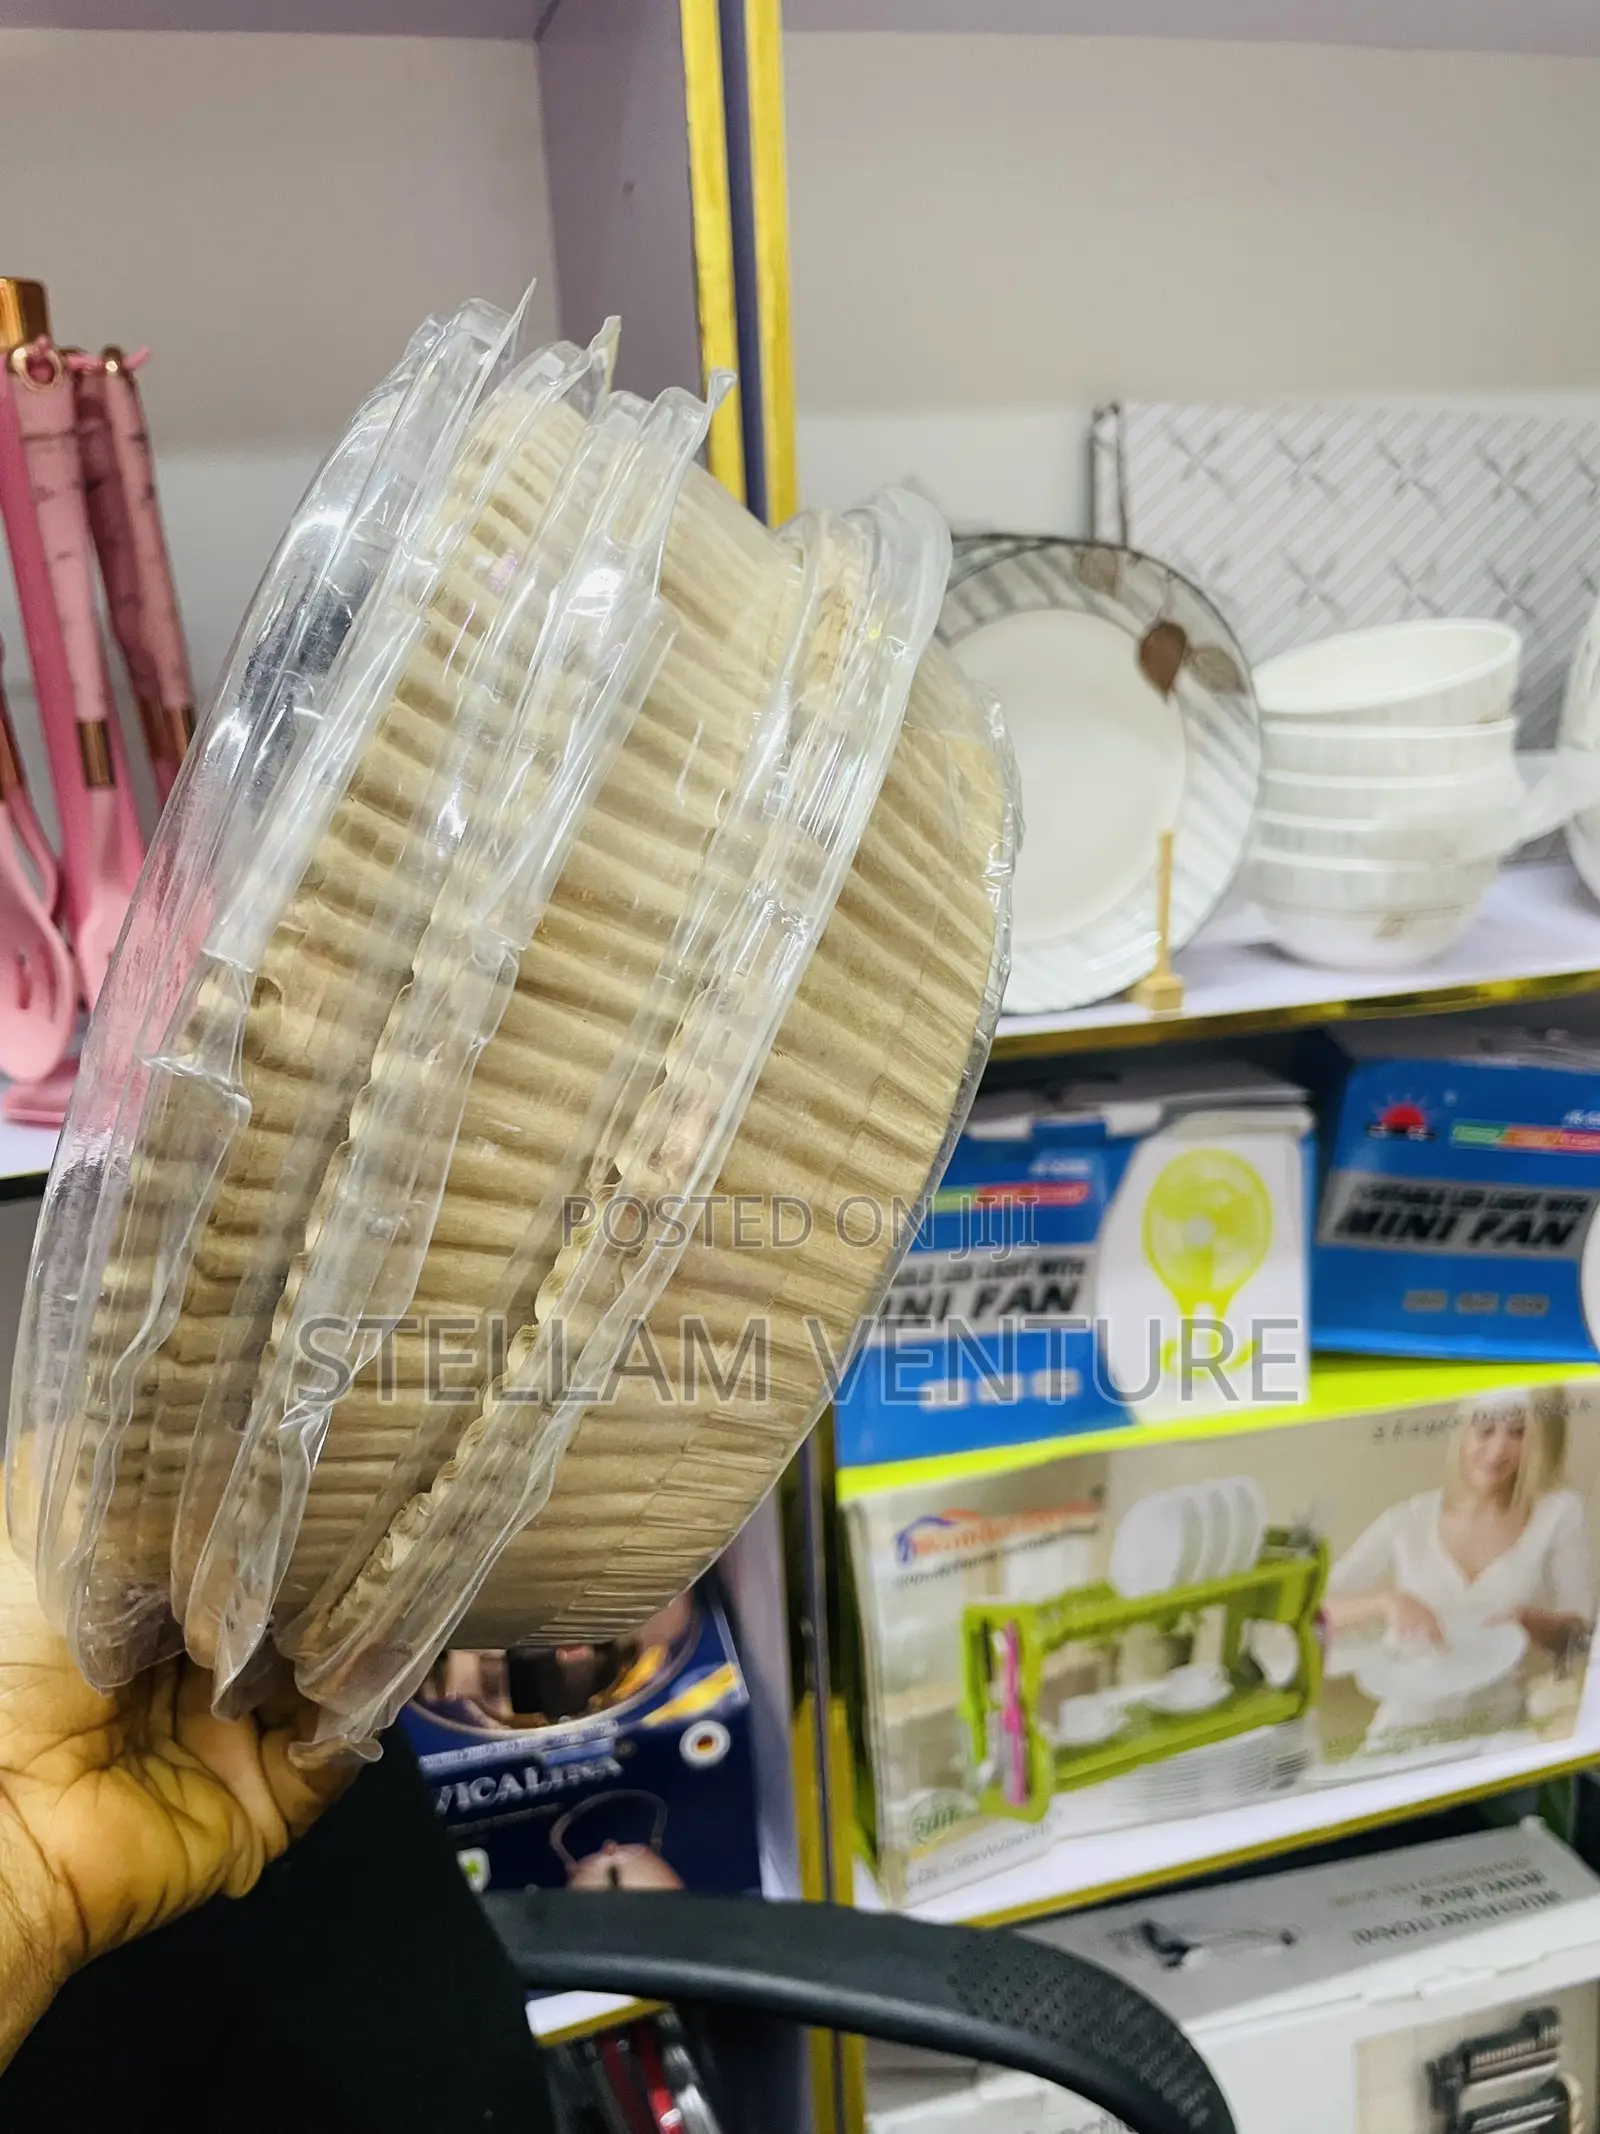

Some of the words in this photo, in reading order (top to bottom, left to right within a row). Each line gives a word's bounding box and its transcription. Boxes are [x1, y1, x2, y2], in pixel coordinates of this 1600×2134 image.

[1334, 1205, 1460, 1245] MINI
[1467, 1210, 1578, 1249] FAN
[969, 1277, 1081, 1319] FAN
